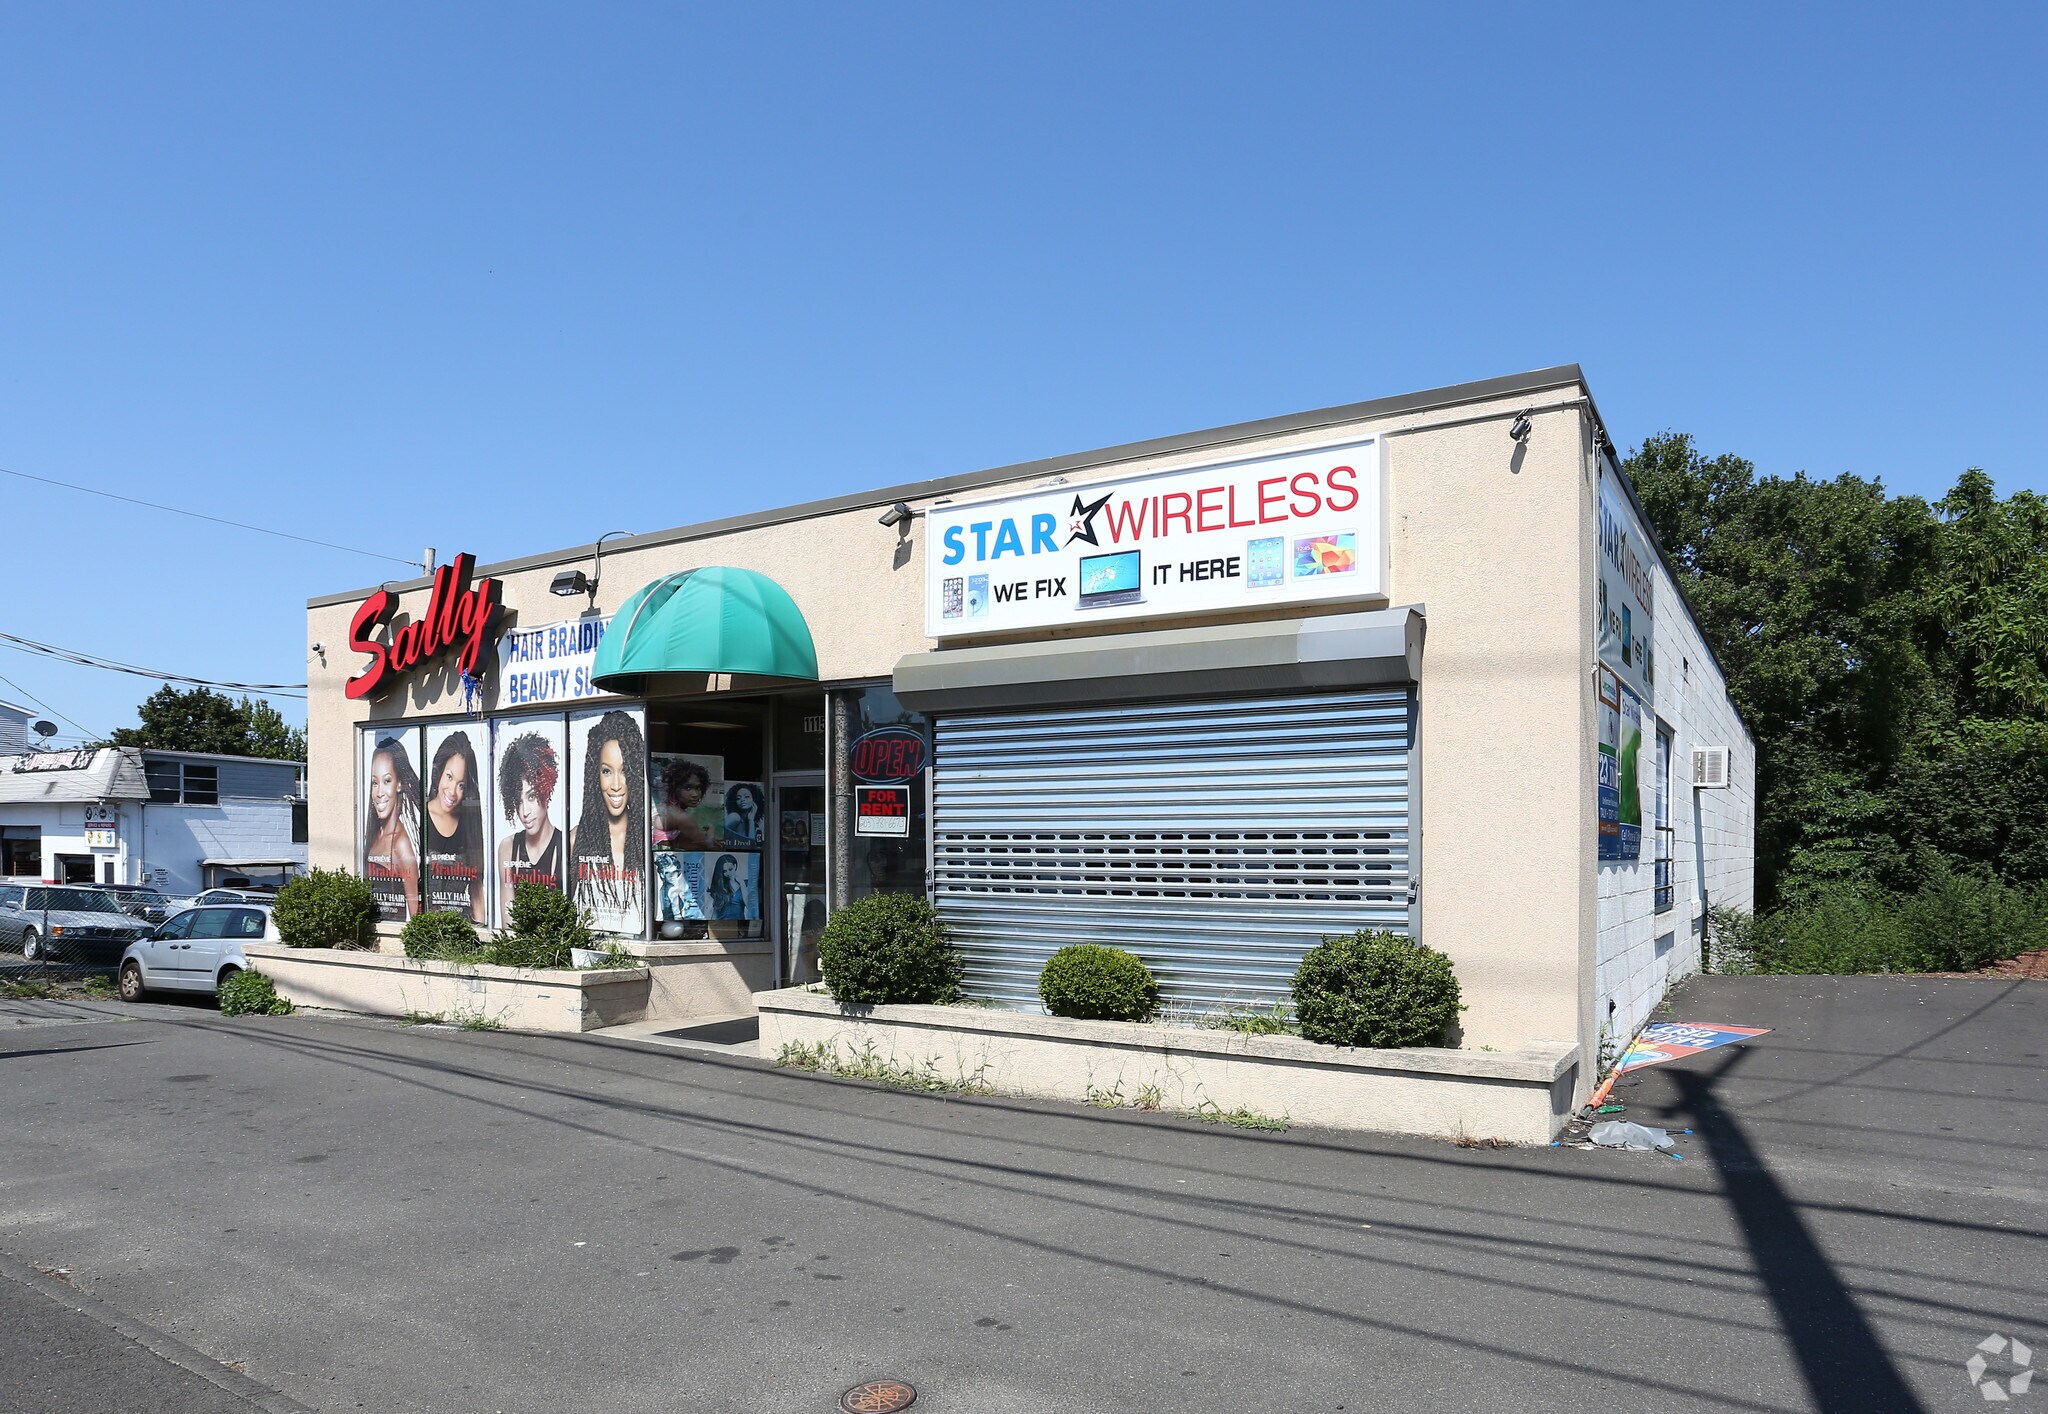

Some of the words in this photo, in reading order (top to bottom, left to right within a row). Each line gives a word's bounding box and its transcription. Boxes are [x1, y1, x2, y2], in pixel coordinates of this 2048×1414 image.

[943, 513, 1060, 566] STAR
[1105, 466, 1359, 543] WIRELESS
[994, 583, 1028, 603] WE
[1035, 577, 1067, 599] FIX
[1153, 564, 1172, 585] IT
[1180, 556, 1241, 583] HERE
[345, 552, 500, 700] Sally
[510, 631, 544, 662] HAIR
[510, 668, 570, 704] BEAUTY
[855, 740, 921, 777] OPEN
[868, 790, 897, 802] FOR
[861, 804, 905, 816] RENT
[368, 862, 412, 879] Braiding
[431, 861, 478, 879] Braiding
[503, 867, 557, 887] Braiding
[389, 893, 405, 902] HAIR
[432, 891, 452, 900] SALLY
[453, 892, 471, 902] HAIR
